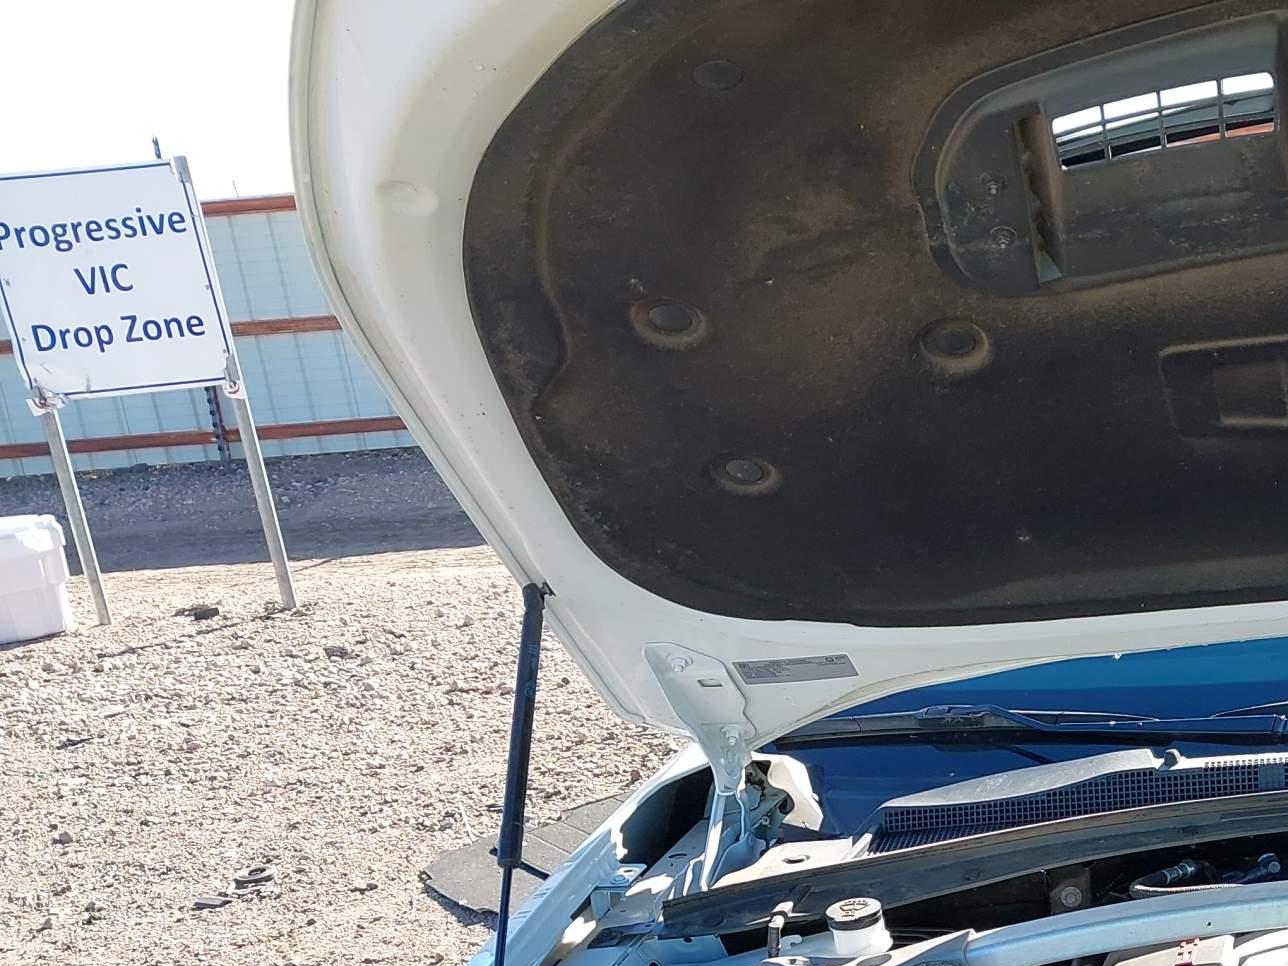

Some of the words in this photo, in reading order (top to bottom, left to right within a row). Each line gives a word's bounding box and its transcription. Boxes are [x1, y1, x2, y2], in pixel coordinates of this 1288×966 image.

[0, 207, 188, 252] Progressive
[73, 263, 134, 295] VIC
[31, 324, 114, 352] Drop
[120, 314, 206, 343] Zone
